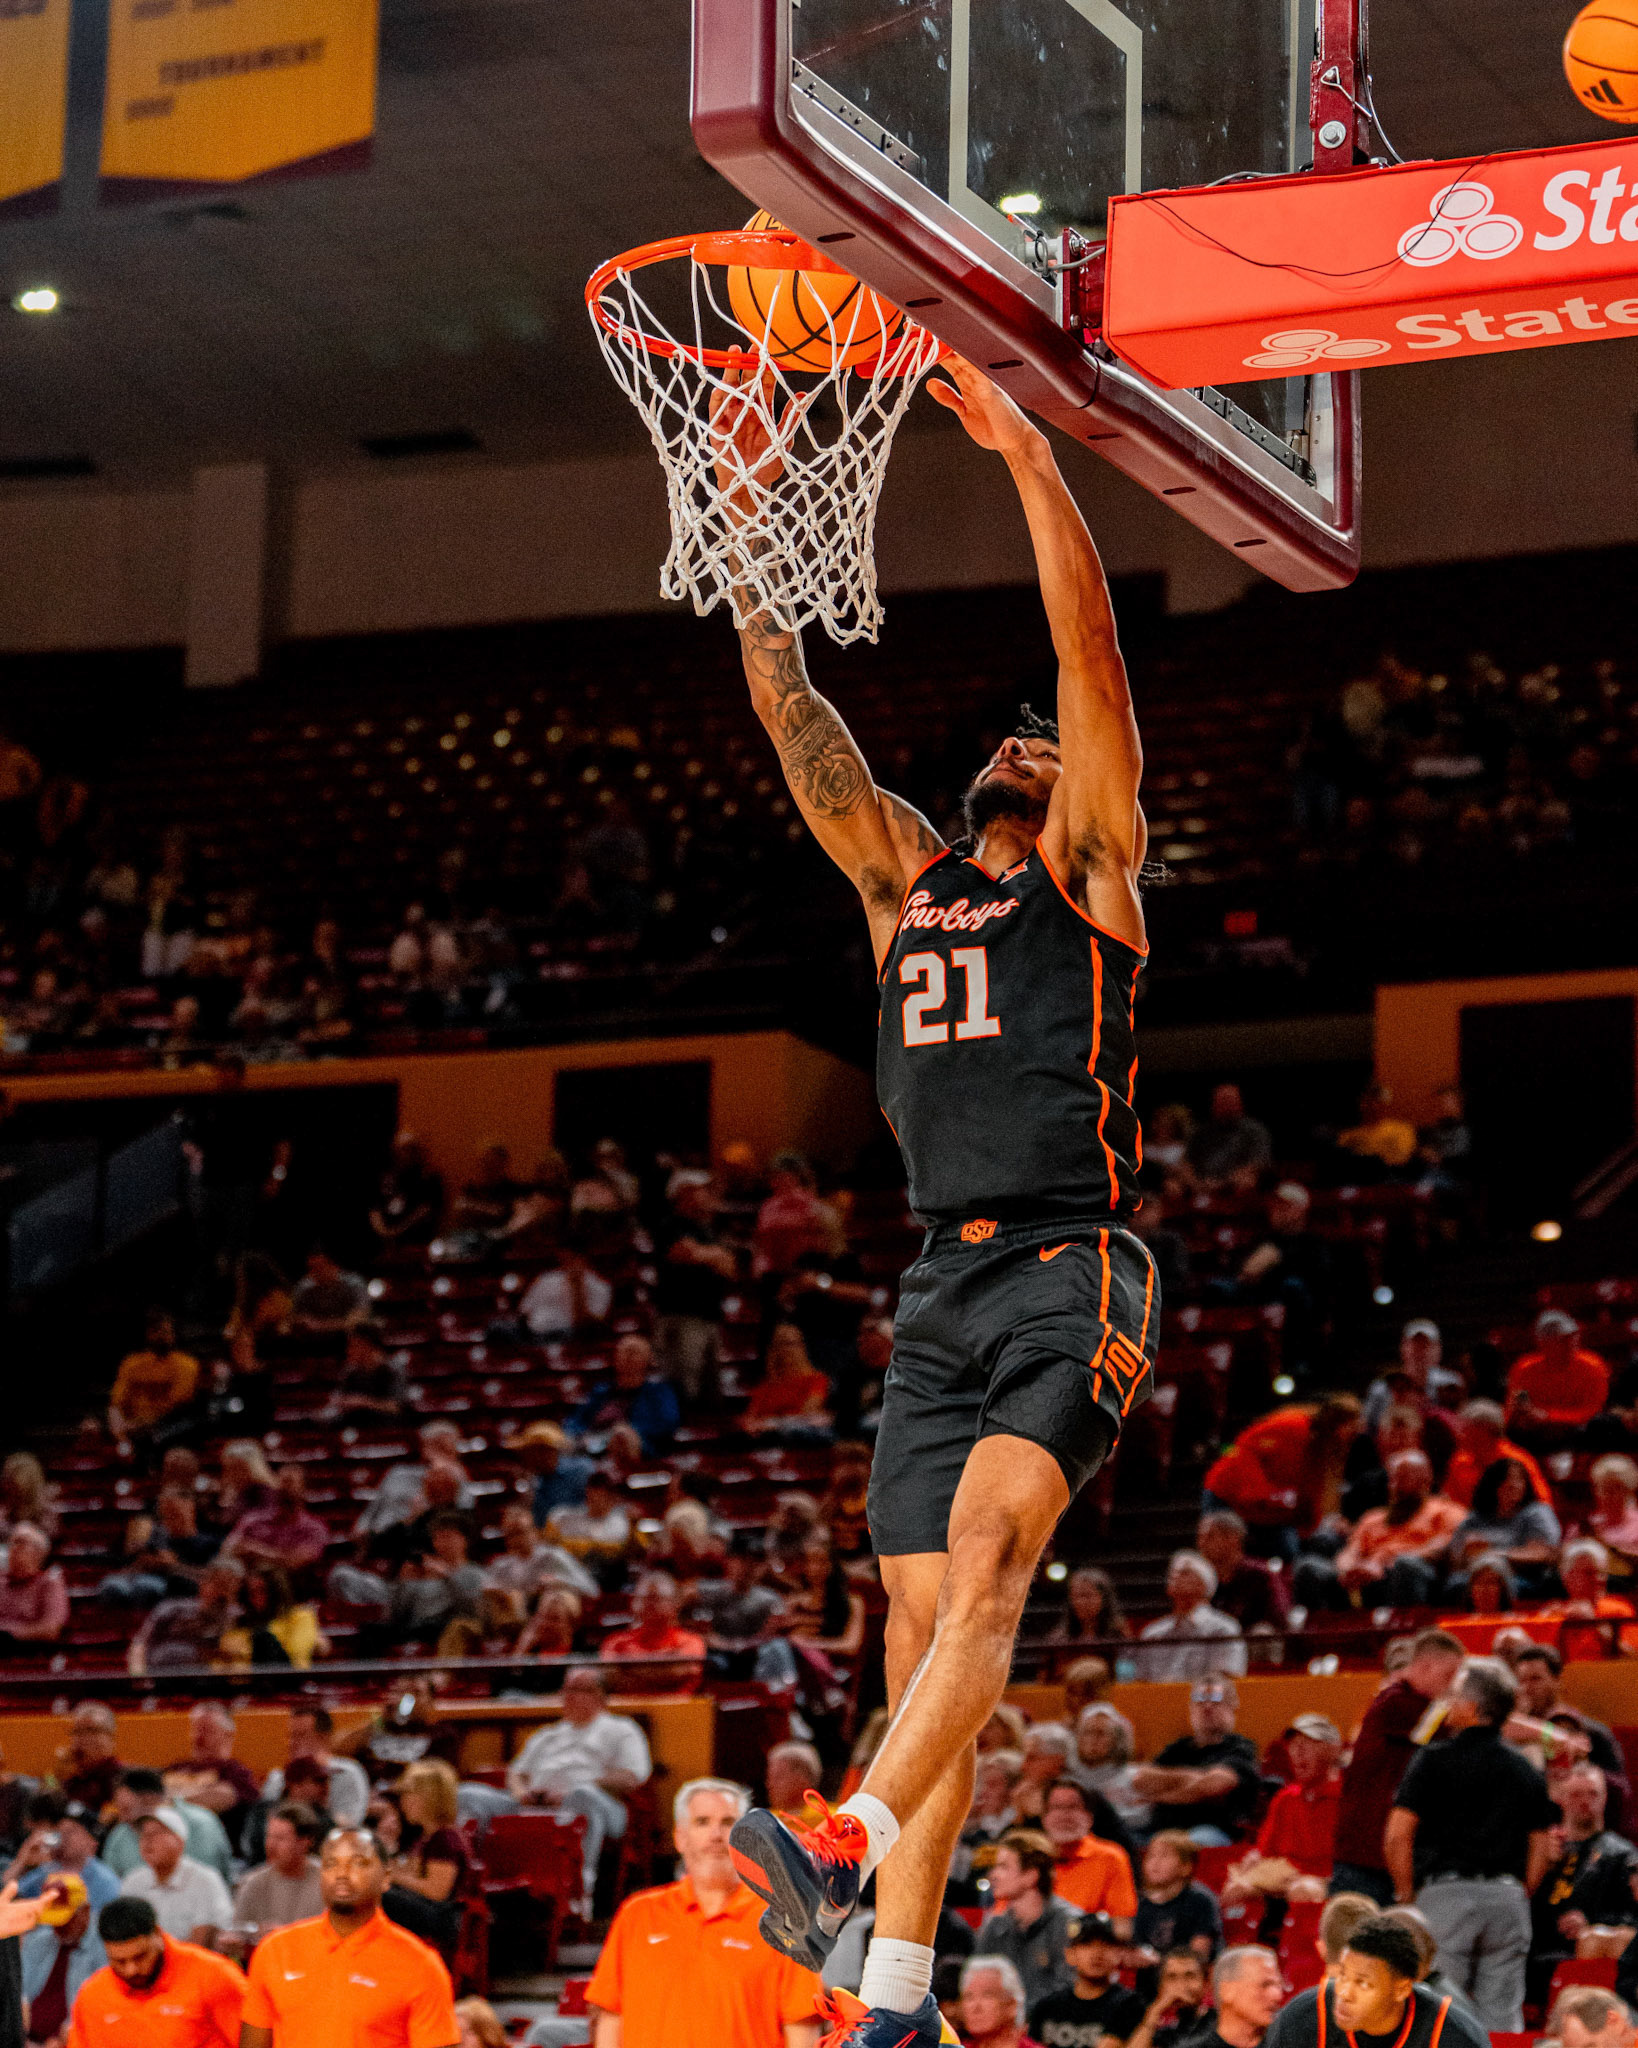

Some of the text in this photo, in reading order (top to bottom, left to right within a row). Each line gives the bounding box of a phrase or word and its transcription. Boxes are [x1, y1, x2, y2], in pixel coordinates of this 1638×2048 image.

[1395, 296, 1638, 349] State
[899, 889, 1020, 936] Cowboys
[899, 946, 1002, 1047] 21
[961, 1218, 998, 1244] OSU
